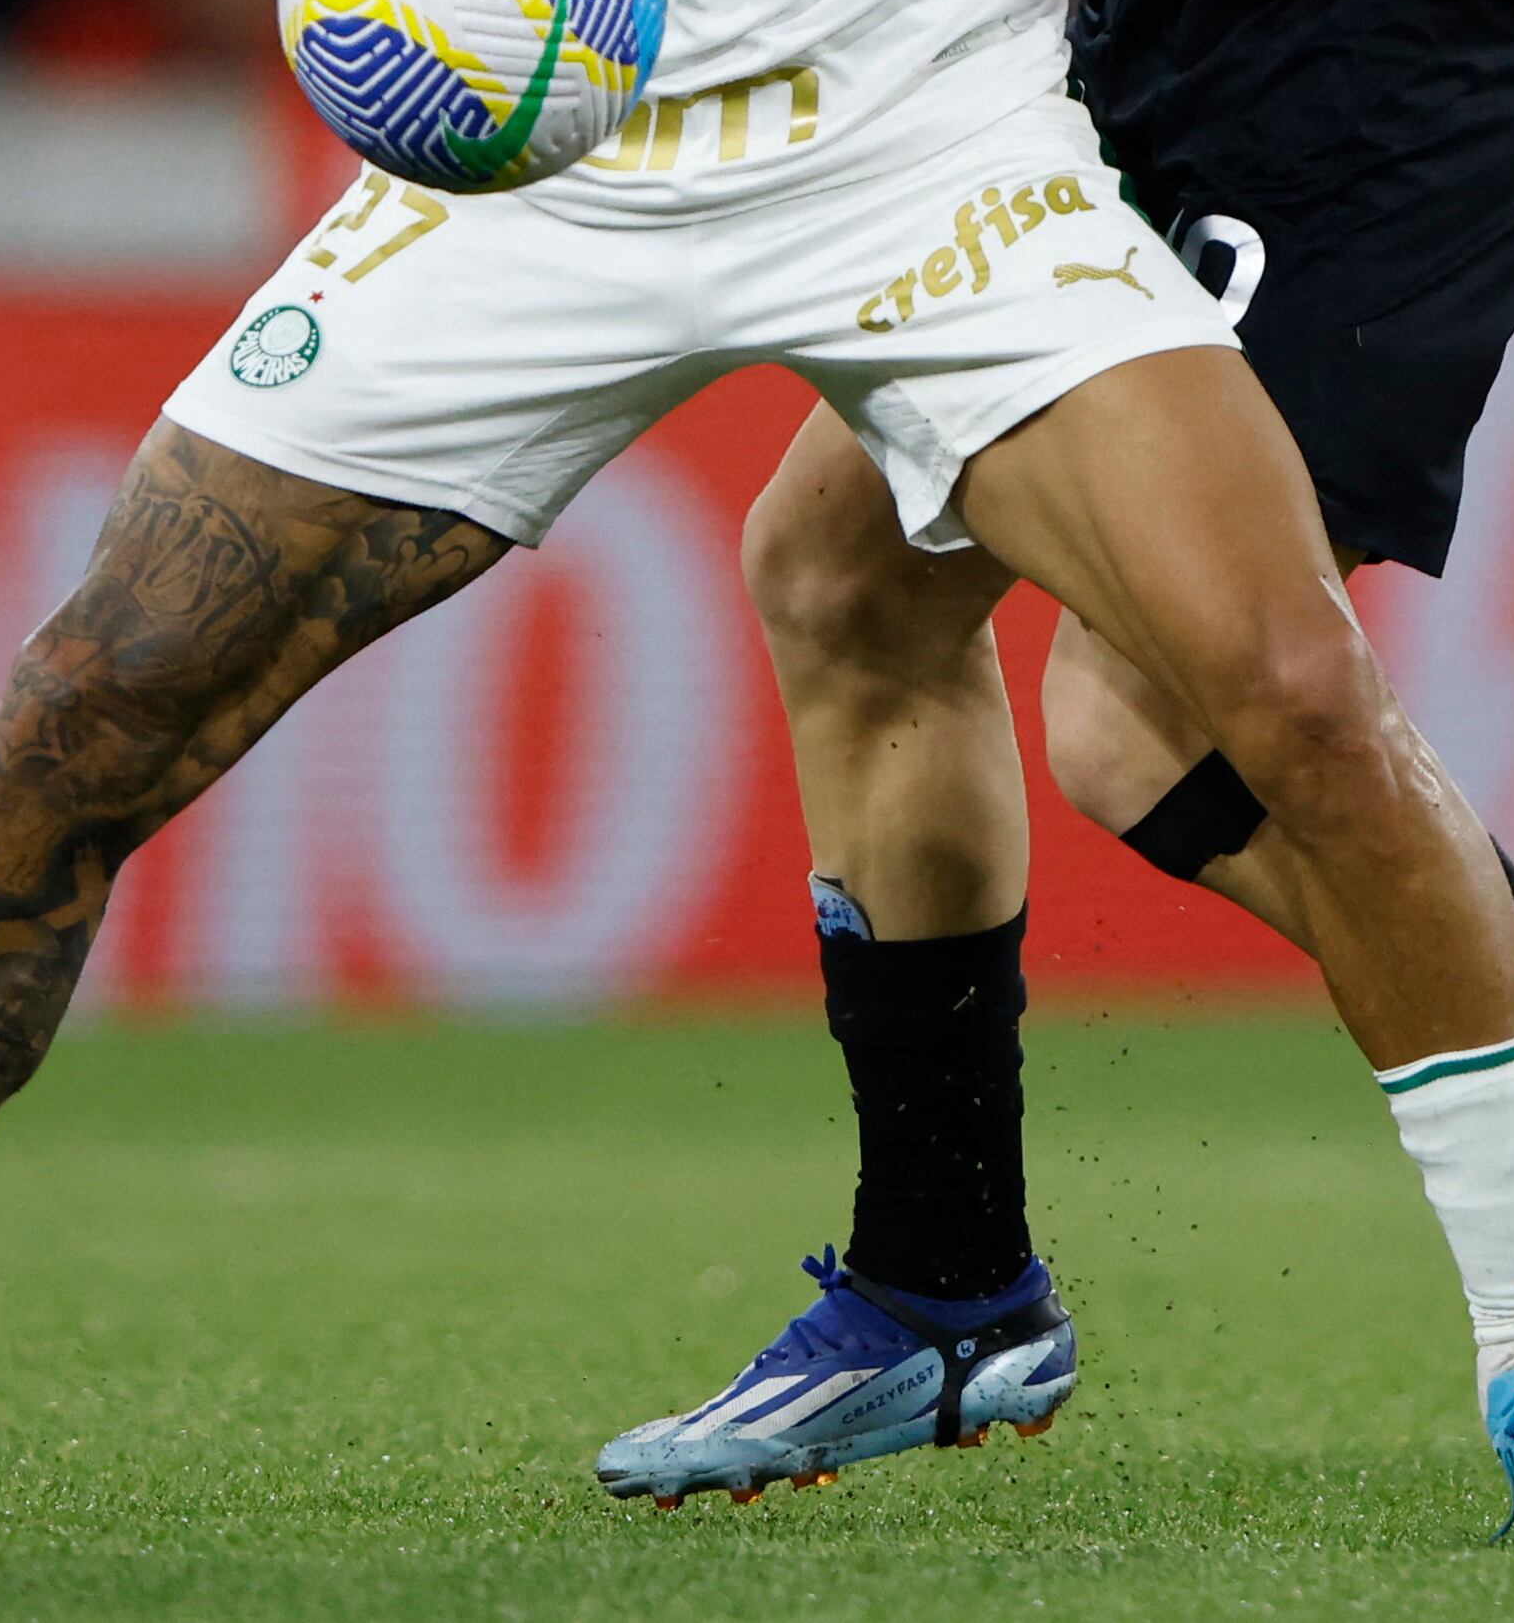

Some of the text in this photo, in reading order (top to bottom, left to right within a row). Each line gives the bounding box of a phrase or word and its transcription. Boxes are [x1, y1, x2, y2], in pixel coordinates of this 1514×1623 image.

[308, 172, 450, 283] 27
[857, 175, 1097, 333] crefisa
[841, 1364, 936, 1425] CRAZYFAST
